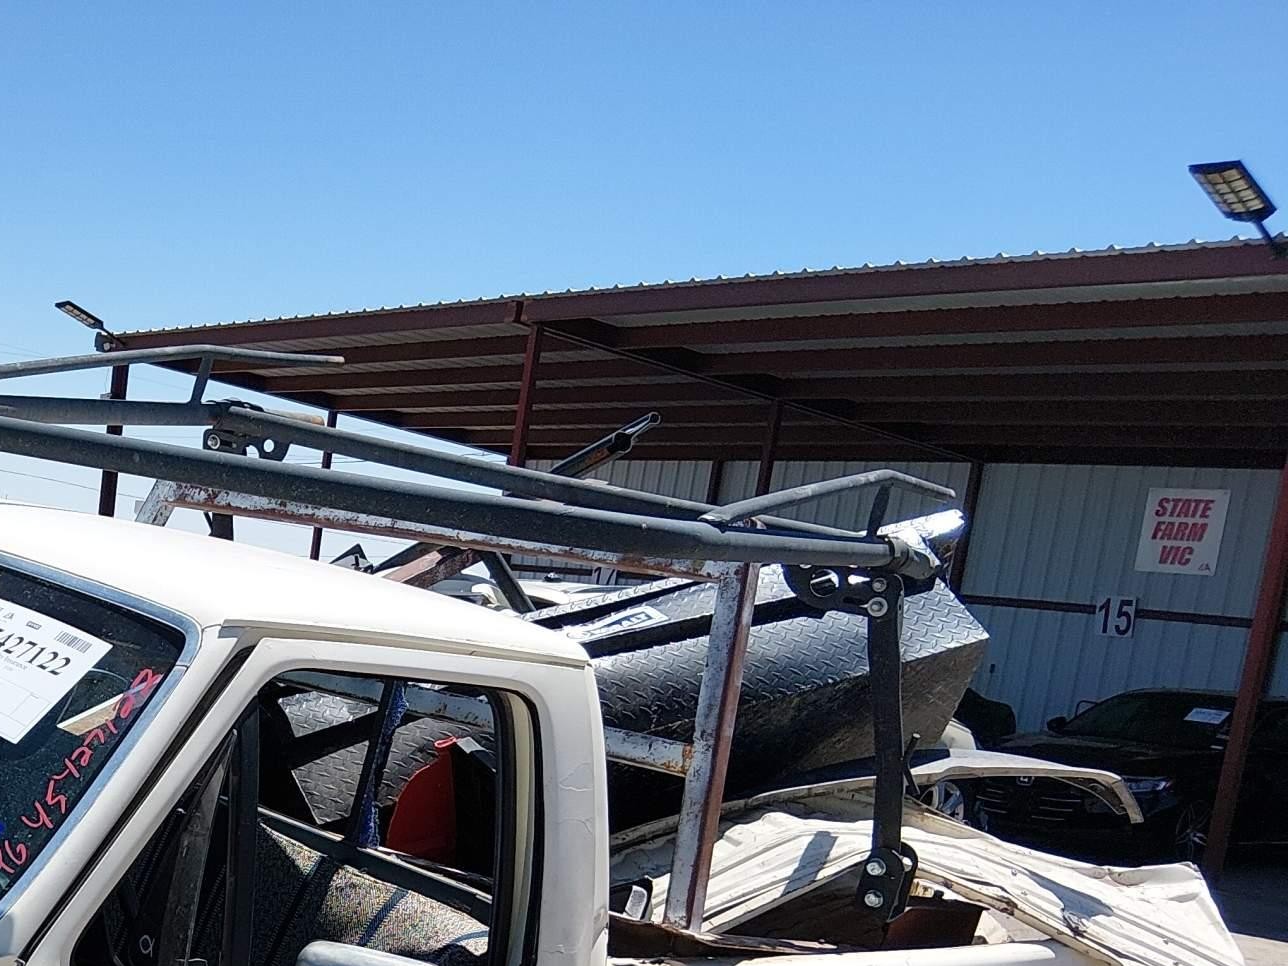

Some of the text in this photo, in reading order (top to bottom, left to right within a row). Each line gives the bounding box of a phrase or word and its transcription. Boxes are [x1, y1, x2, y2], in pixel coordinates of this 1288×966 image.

[1155, 498, 1216, 519] STATE
[1151, 521, 1209, 542] FARM
[1159, 545, 1194, 566] VIC
[1098, 598, 1134, 636] 15
